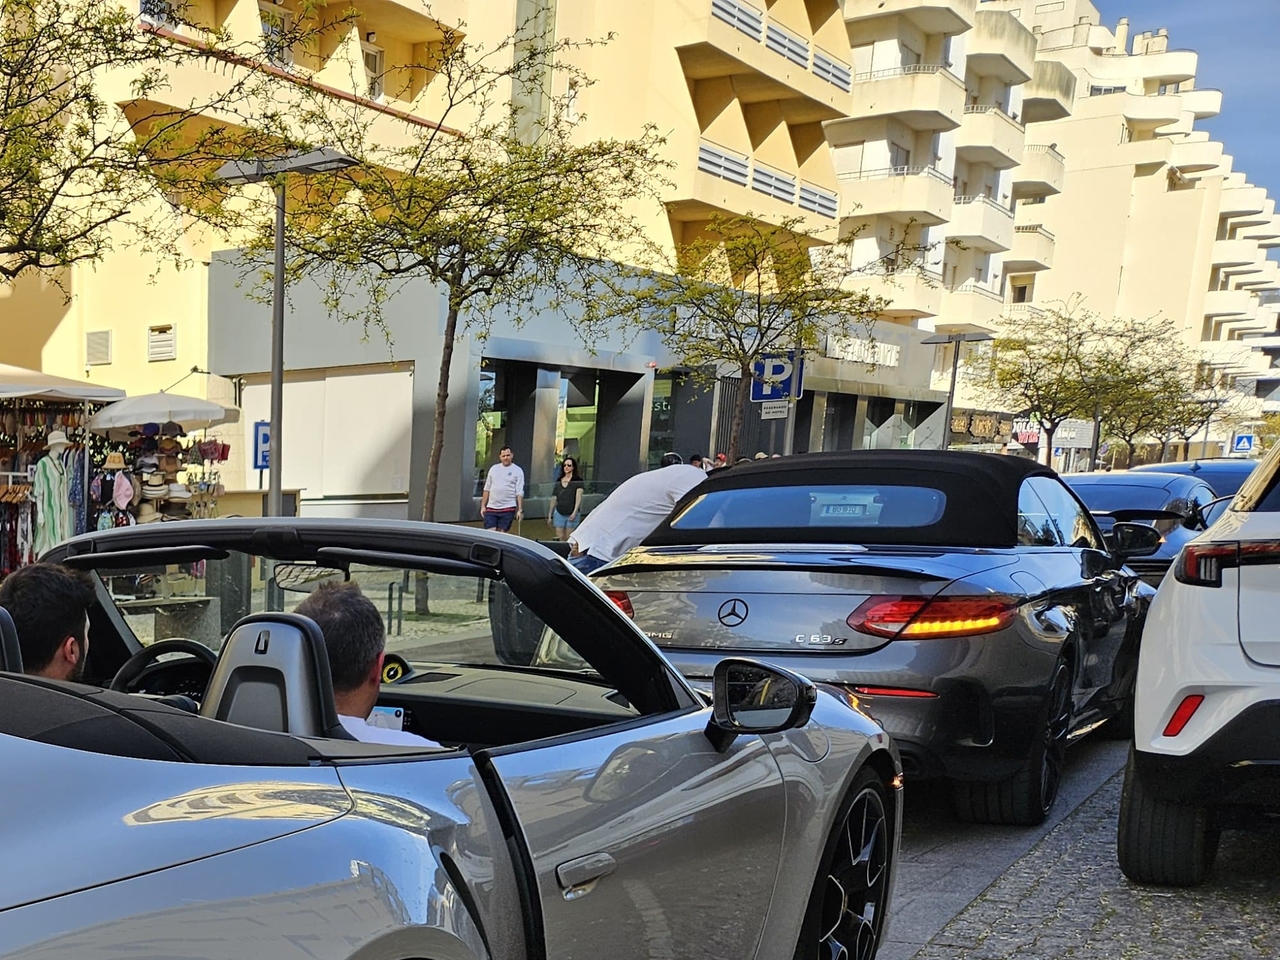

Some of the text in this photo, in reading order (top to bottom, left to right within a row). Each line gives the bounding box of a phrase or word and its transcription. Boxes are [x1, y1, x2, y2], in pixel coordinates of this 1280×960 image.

[762, 358, 793, 395] P
[795, 634, 805, 643] C
[810, 634, 831, 643] 63
